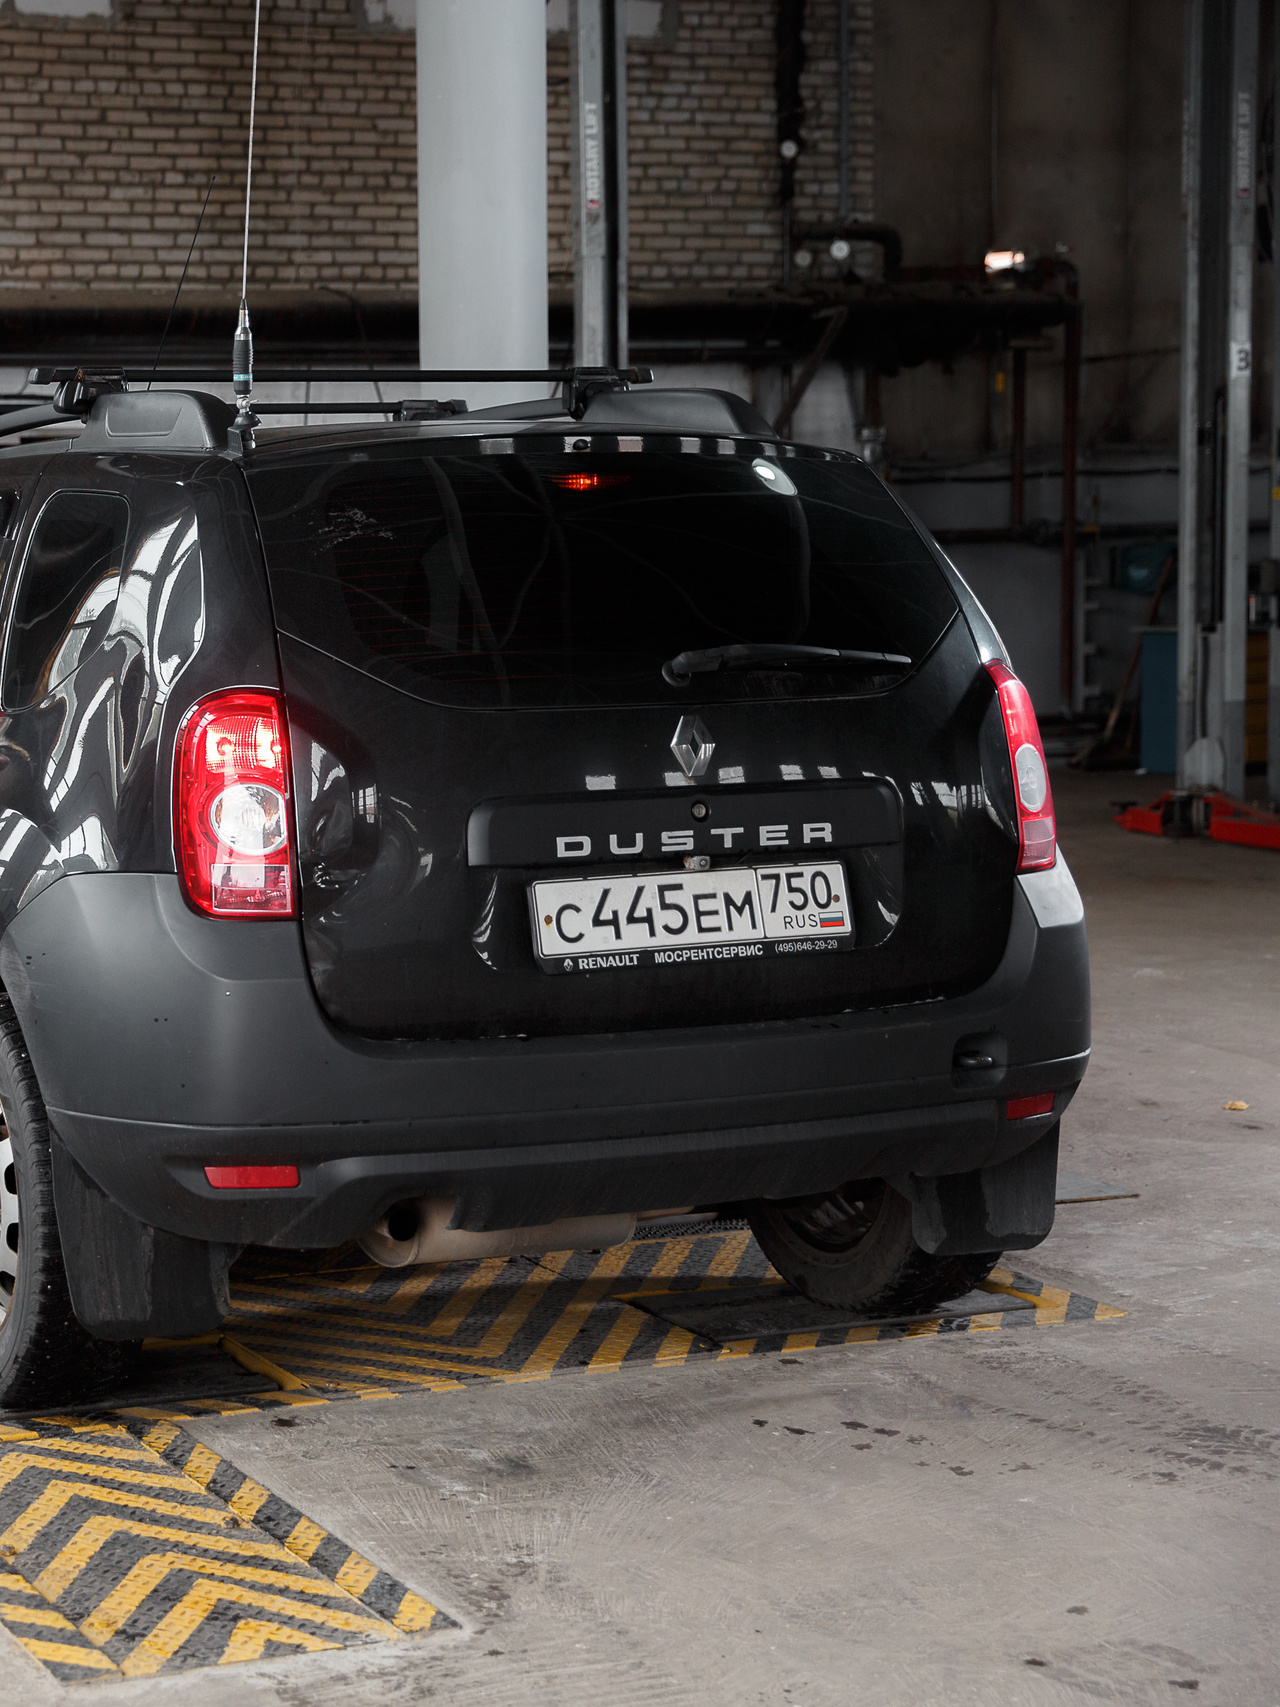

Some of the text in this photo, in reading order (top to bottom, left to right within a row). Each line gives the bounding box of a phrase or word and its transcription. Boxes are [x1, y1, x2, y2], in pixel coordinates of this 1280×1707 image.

[584, 102, 600, 200] ROTARY LIFT
[1237, 349, 1249, 371] 3
[556, 822, 833, 858] DUSTER
[760, 870, 833, 914] 750
[783, 913, 818, 930] RUS
[654, 944, 764, 964] МОСРЕНТСЕРВИС
[774, 939, 838, 954] (495)646-29-29
[578, 953, 640, 970] RENAULT
